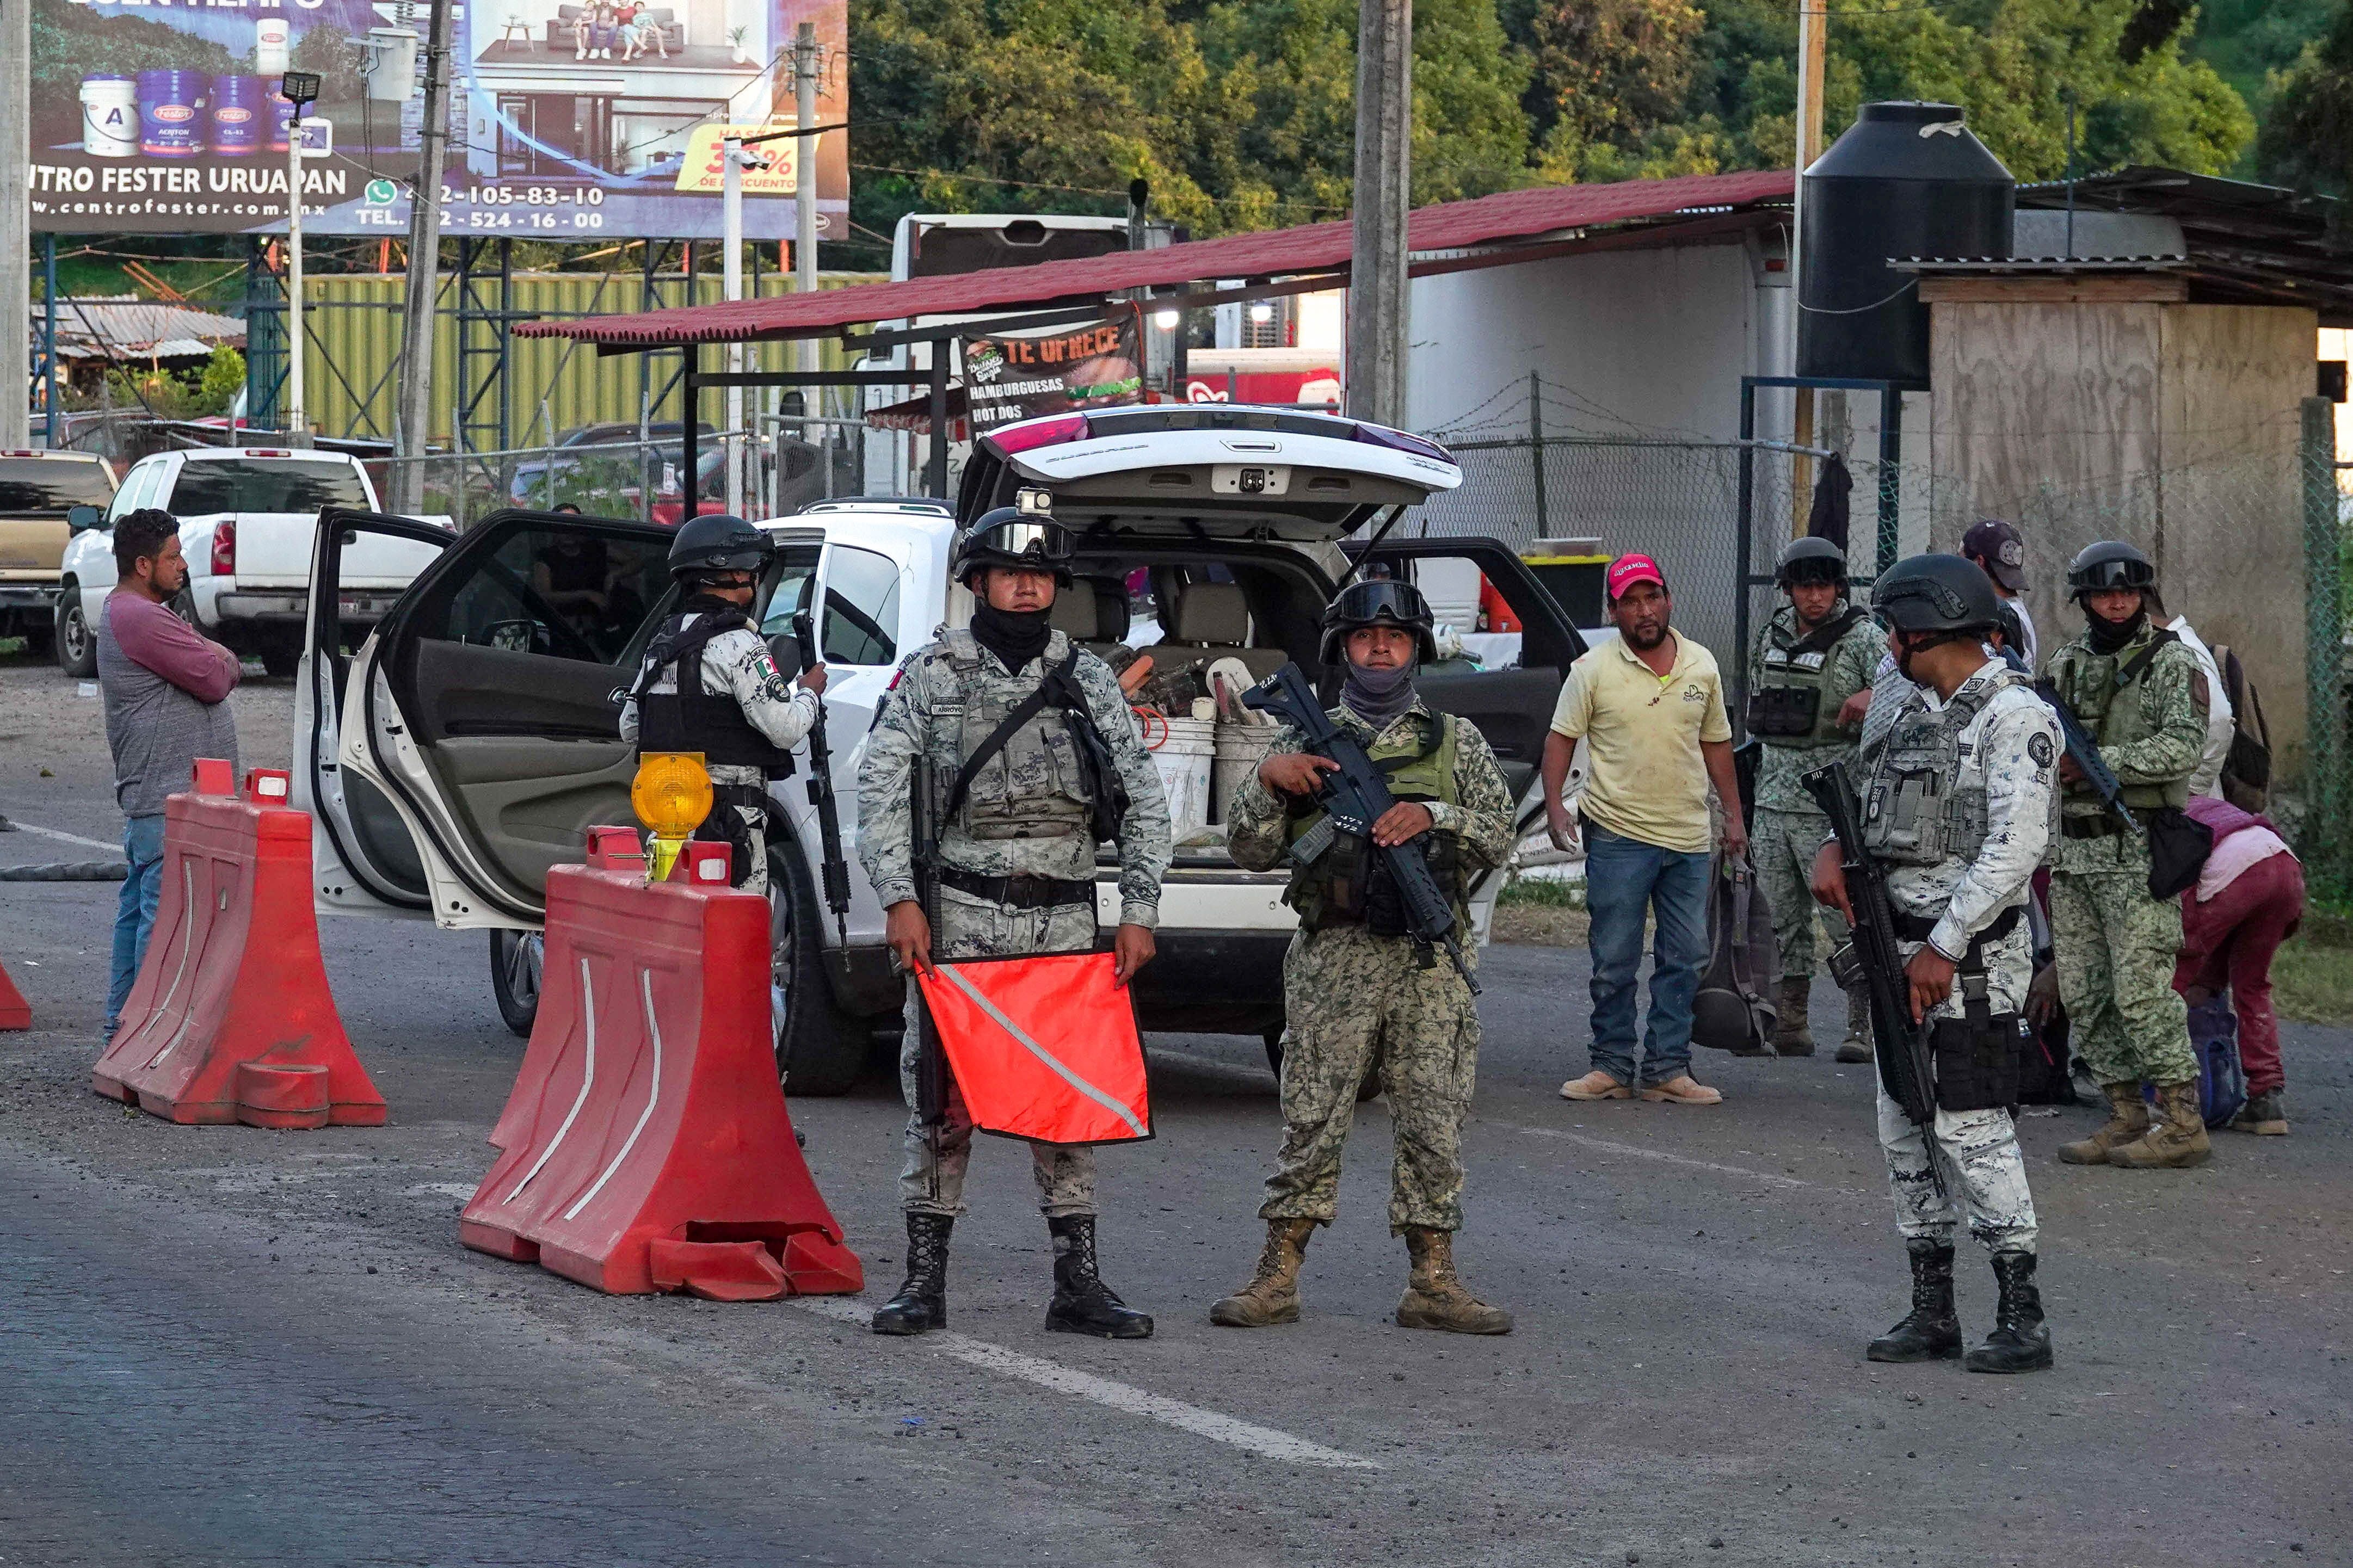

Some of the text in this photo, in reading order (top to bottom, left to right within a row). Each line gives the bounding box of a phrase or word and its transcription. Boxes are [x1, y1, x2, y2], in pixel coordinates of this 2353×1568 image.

[105, 108, 123, 124] A
[102, 167, 202, 193] FESTER
[700, 178, 717, 187] DE
[355, 208, 405, 225] TEL.
[1003, 340, 1035, 364] TE
[969, 378, 1064, 400] HAMBURGUESAS
[972, 408, 996, 423] HOT
[1967, 680, 1980, 688] GN
